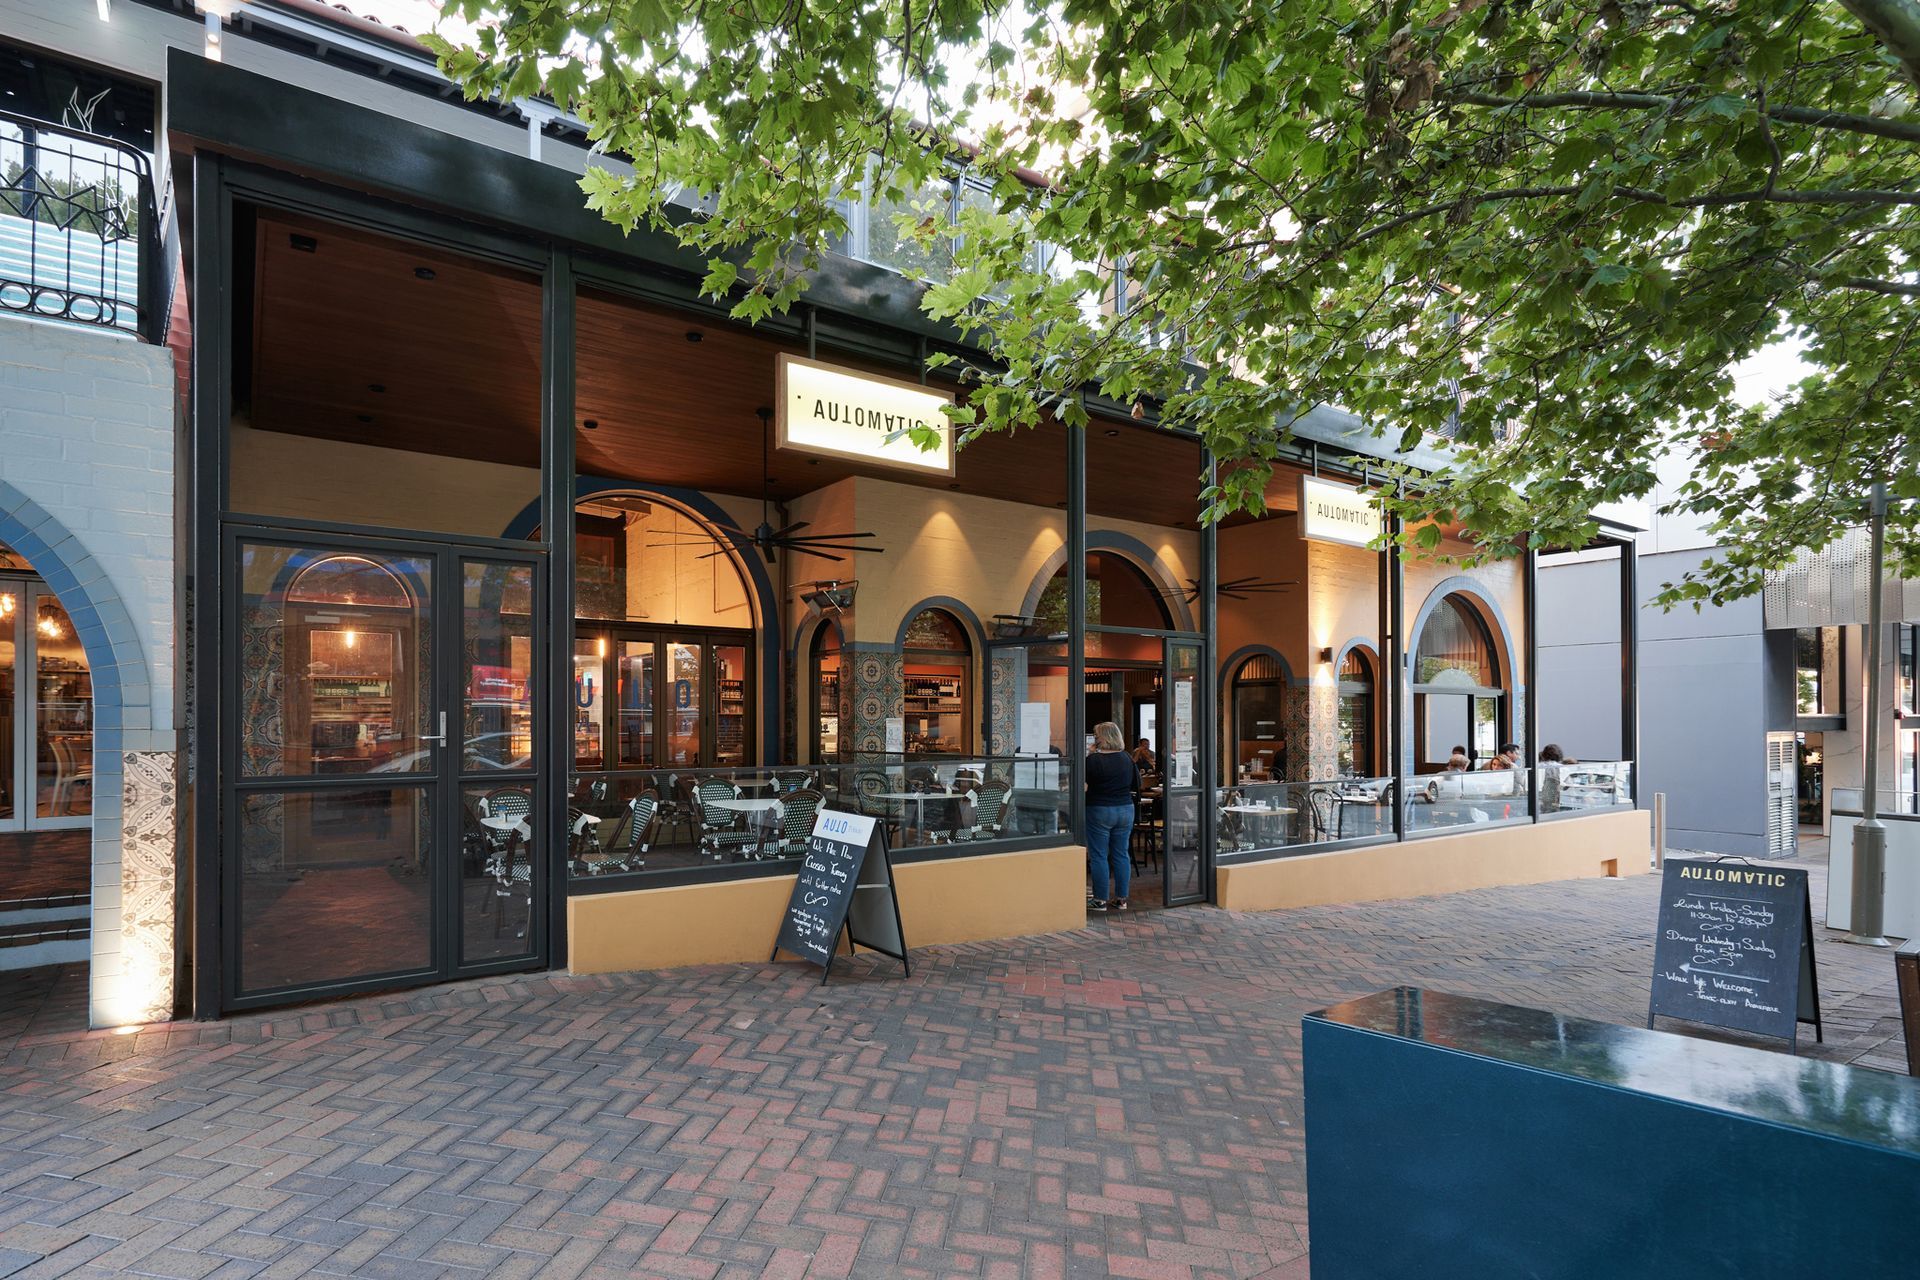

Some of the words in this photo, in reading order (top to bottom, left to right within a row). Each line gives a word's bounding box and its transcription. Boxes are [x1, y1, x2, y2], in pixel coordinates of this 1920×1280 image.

[1317, 503, 1369, 526] AUTOMATIC
[822, 817, 848, 834] AUTO
[1680, 866, 1786, 887] AUTOMATIC
[1673, 898, 1705, 911] Lunch
[1725, 913, 1735, 923] to
[1666, 929, 1698, 943] Dinner
[1719, 947, 1744, 959] 5pm
